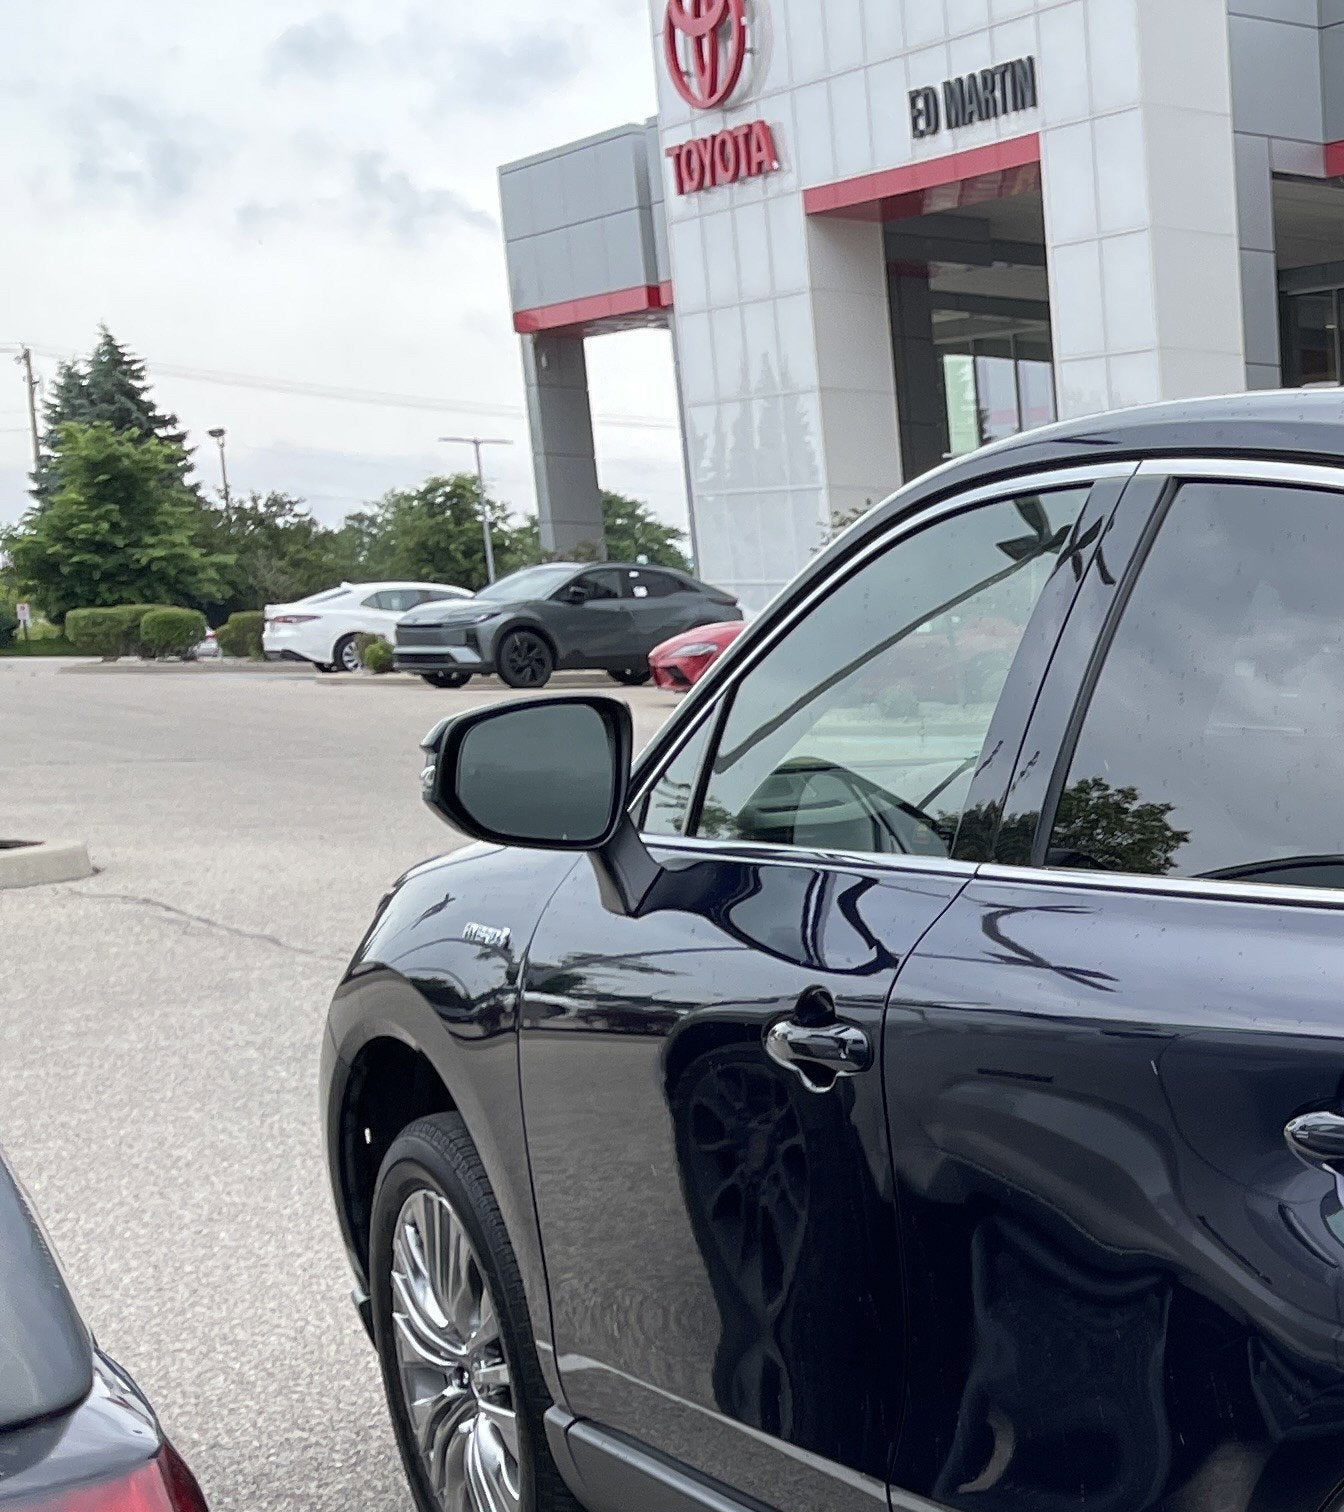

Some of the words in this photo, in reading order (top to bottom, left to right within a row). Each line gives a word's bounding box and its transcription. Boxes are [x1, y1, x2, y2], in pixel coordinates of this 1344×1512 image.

[907, 85, 940, 139] ED
[941, 55, 1037, 130] MARTIN
[665, 119, 778, 195] TOYOTA
